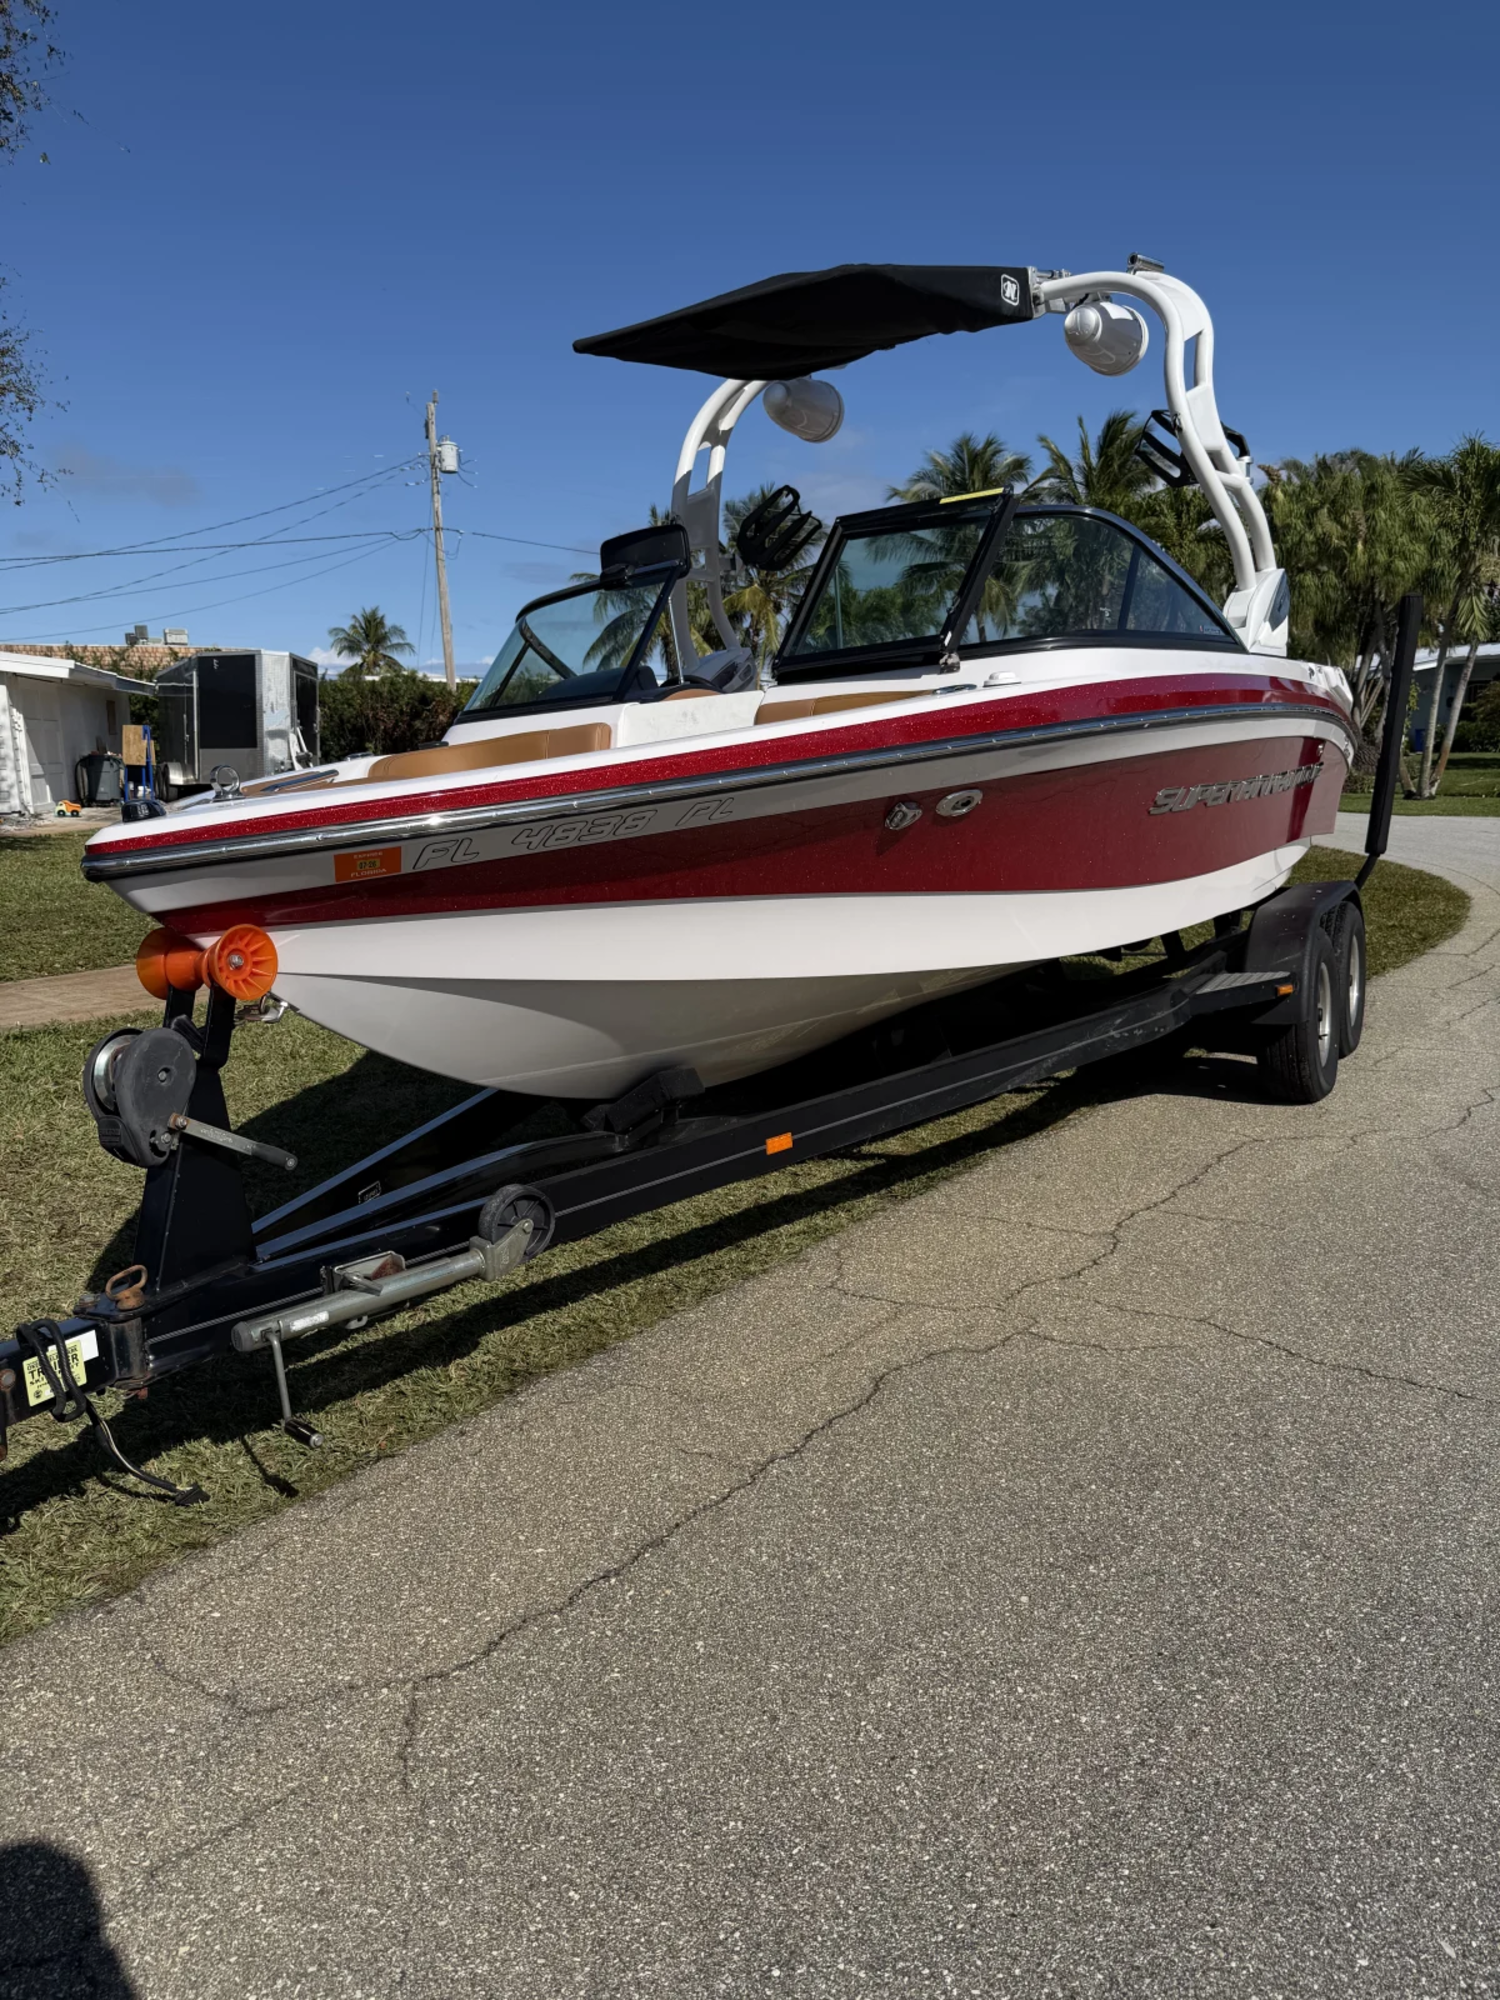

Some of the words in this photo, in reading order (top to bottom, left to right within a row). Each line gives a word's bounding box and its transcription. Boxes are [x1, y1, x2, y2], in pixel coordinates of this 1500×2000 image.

[413, 837, 480, 870] FL
[512, 809, 658, 850] 4838
[358, 860, 377, 869] 07-26
[350, 868, 387, 878] FLORIDA
